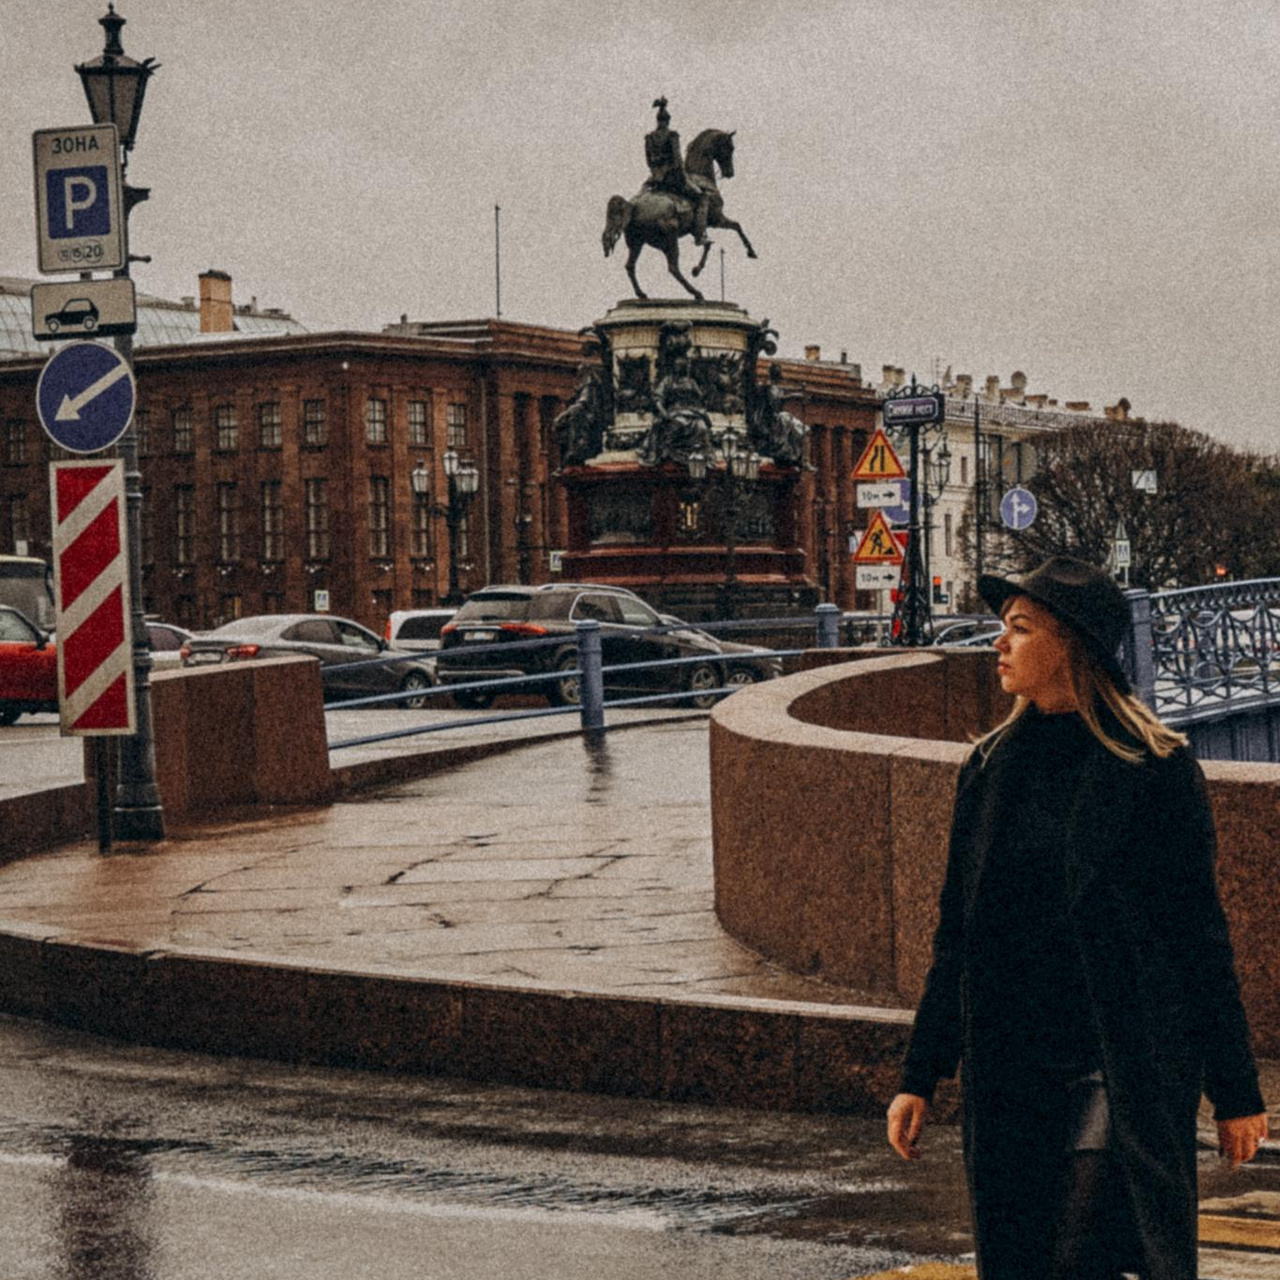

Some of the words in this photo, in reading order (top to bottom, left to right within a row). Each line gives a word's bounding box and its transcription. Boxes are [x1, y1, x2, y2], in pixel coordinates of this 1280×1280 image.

[52, 136, 100, 154] ЗОНА
[64, 176, 97, 229] P
[85, 244, 102, 258] 20
